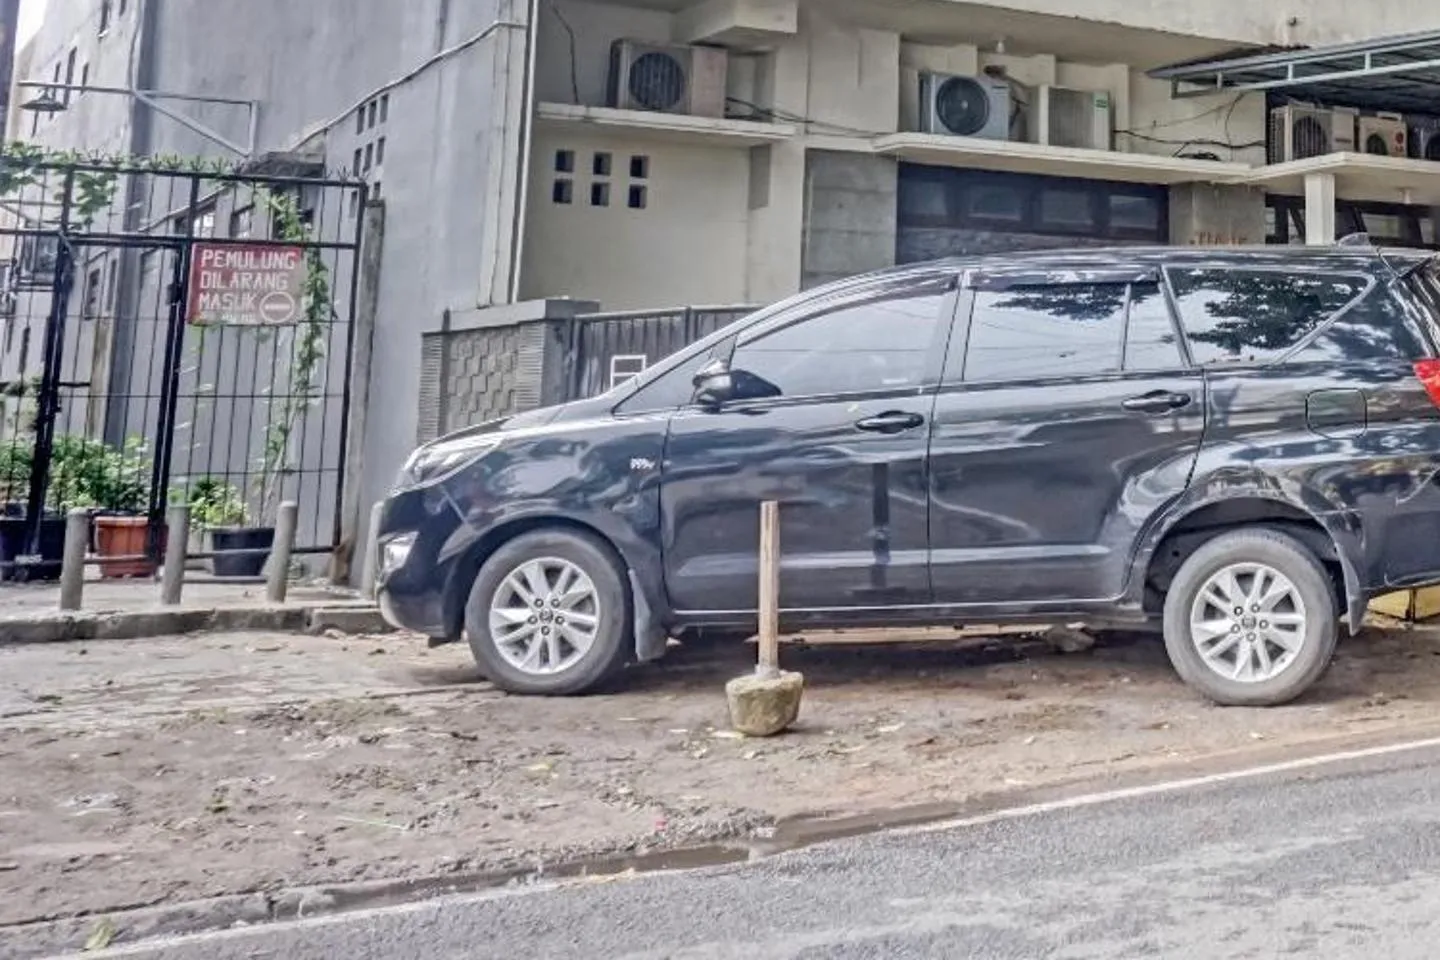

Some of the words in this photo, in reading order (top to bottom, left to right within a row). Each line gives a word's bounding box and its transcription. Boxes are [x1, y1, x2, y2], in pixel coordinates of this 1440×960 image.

[201, 249, 295, 269] PEMULUNG
[200, 271, 289, 290] DILARANG
[198, 291, 259, 310] MASUK
